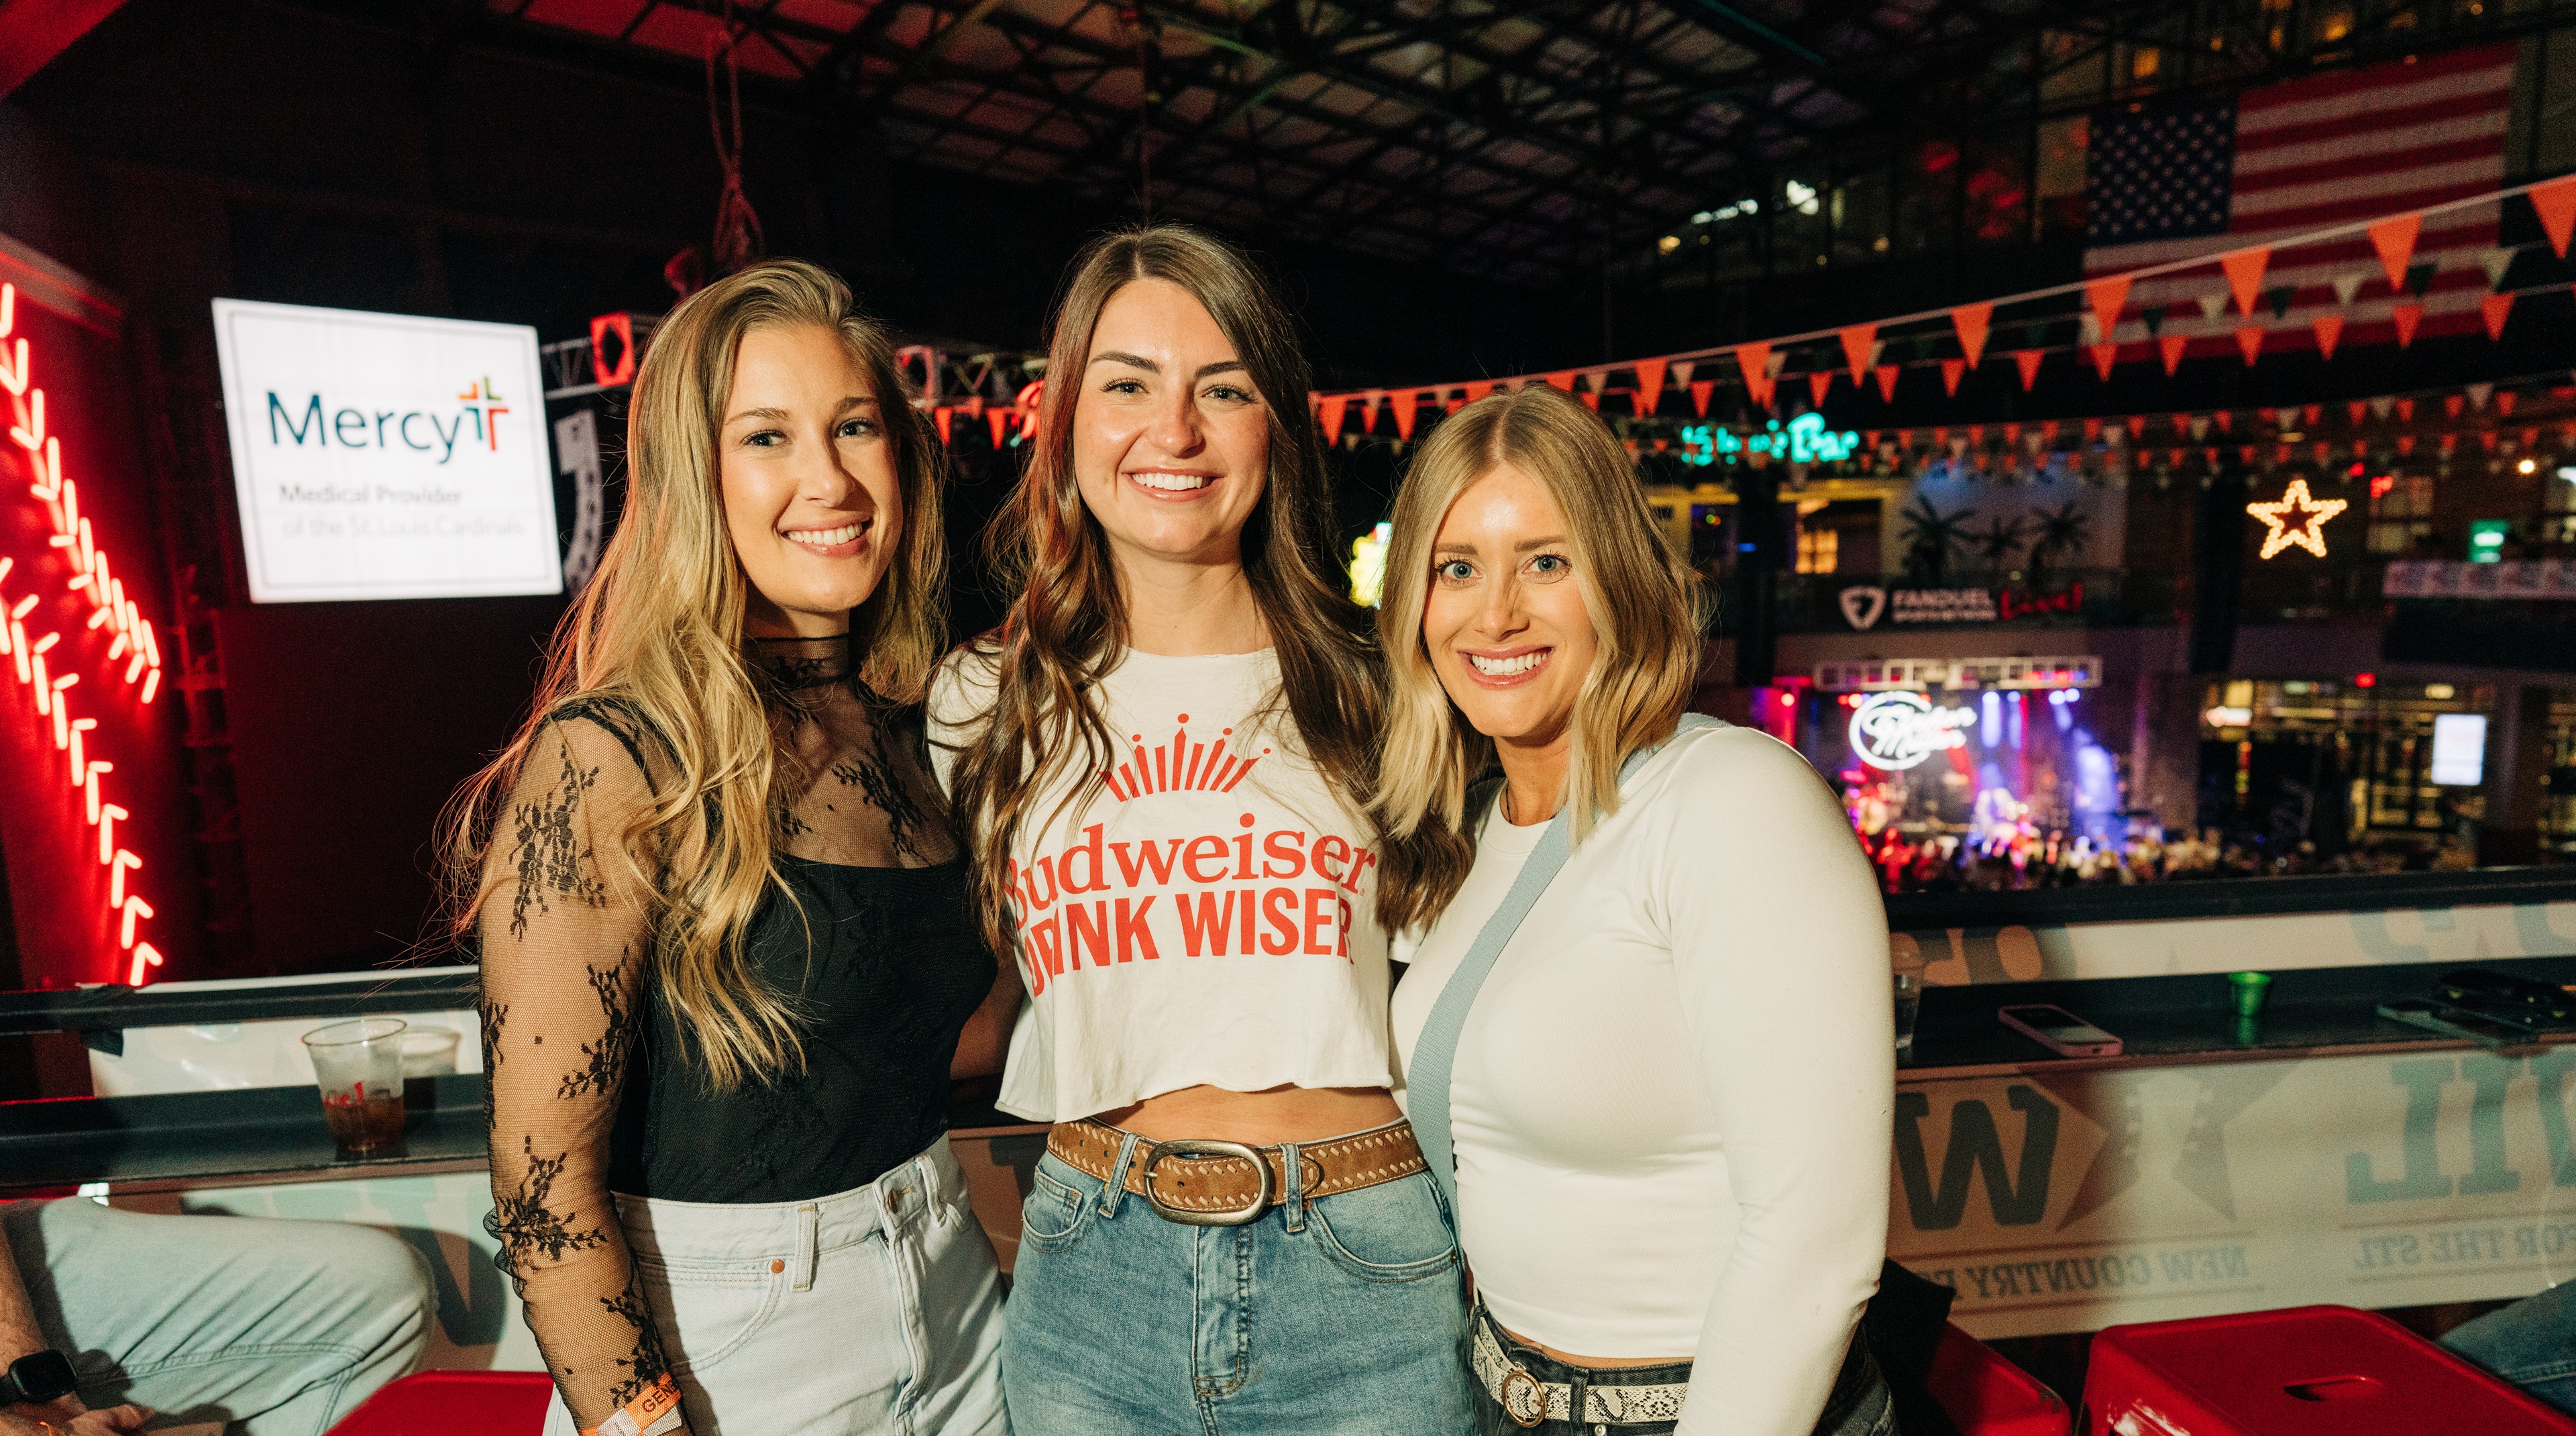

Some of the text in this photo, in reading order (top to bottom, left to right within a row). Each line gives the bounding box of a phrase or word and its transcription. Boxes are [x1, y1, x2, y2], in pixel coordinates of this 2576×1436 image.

[266, 391, 461, 464] Mercy
[279, 483, 463, 507] Medical Provider
[1005, 812, 1376, 931] Budweiser
[1175, 887, 1354, 965] WISER
